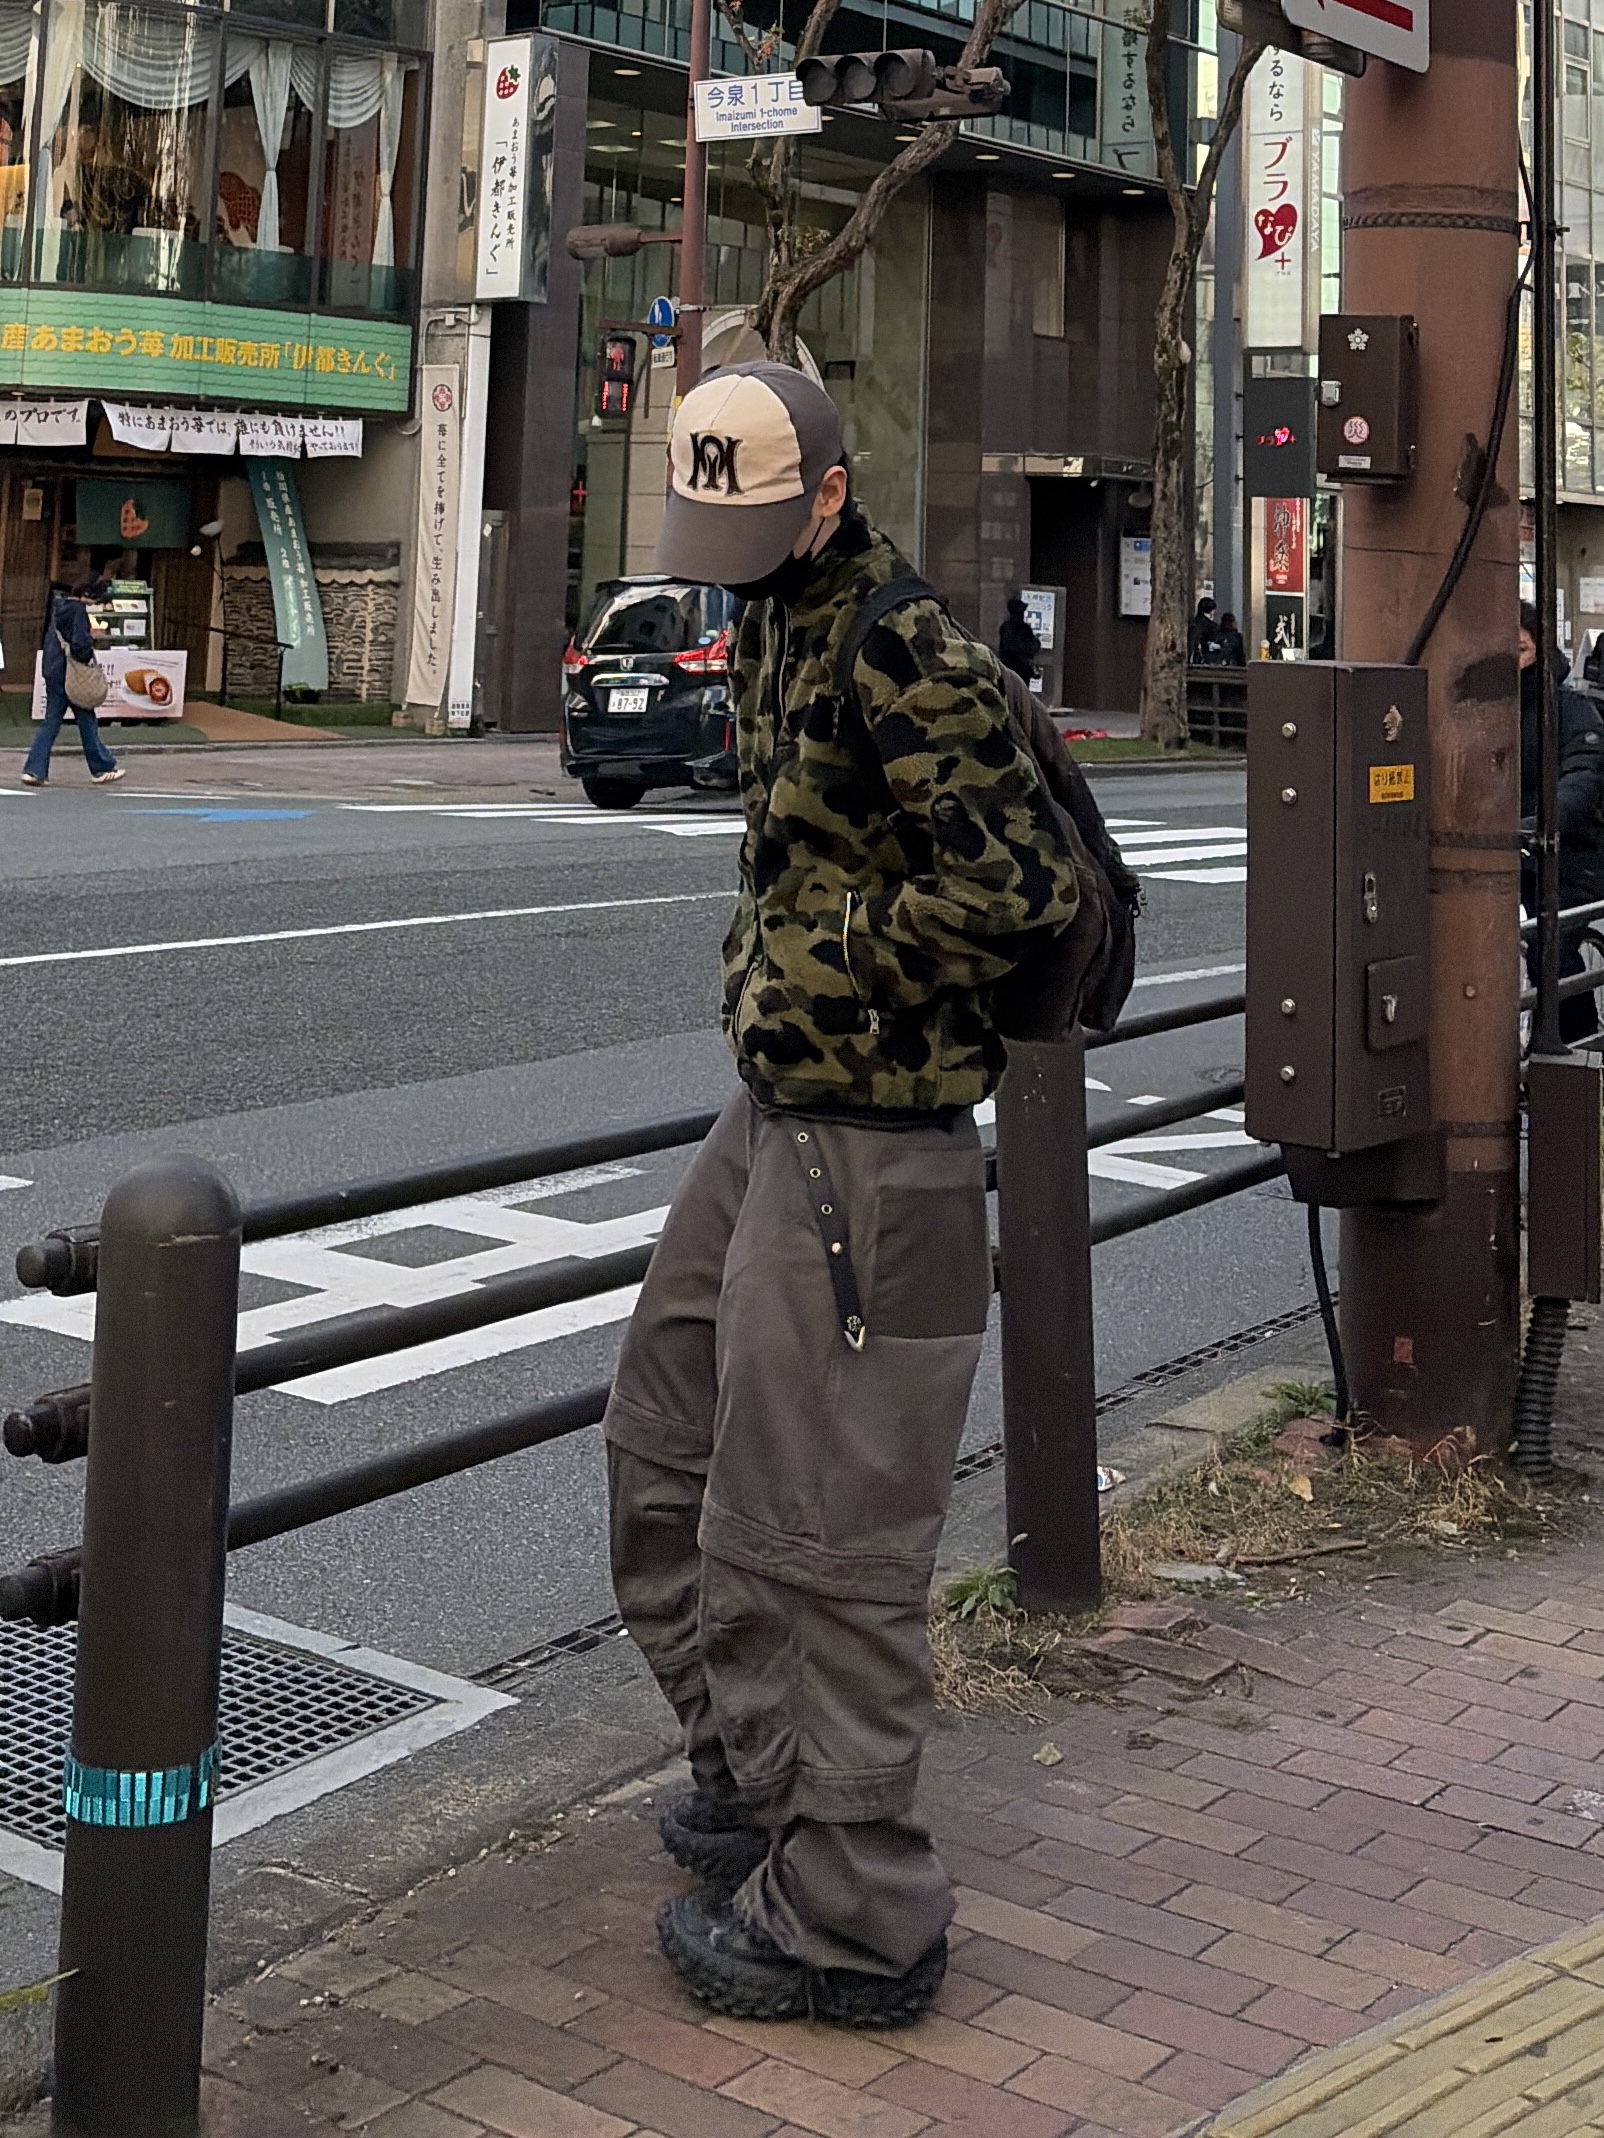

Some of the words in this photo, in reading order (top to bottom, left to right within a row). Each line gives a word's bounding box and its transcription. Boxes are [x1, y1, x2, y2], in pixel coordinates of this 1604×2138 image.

[716, 111, 757, 122] Imaizumi
[760, 106, 798, 118] 1-chome
[731, 120, 784, 132] Intersection
[1310, 151, 1320, 252] YAMADAYA
[1348, 420, 1364, 440] 災
[617, 697, 645, 711] 87-92
